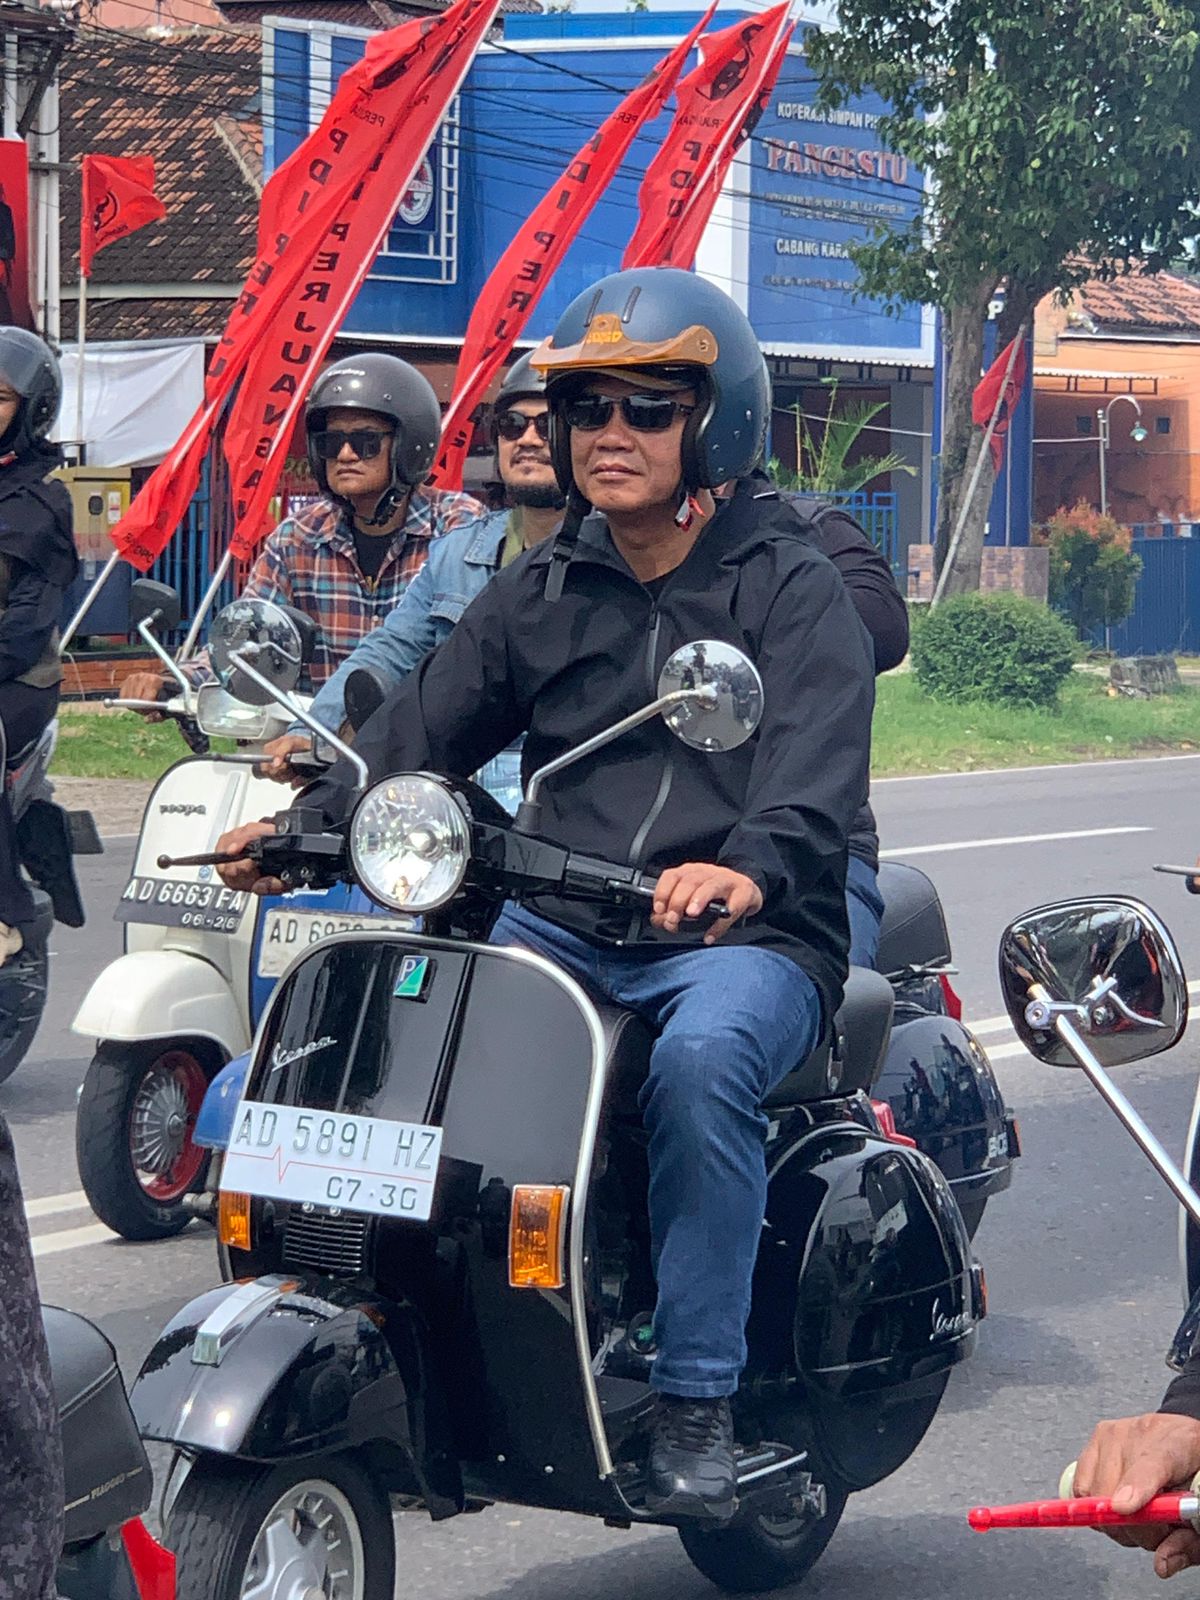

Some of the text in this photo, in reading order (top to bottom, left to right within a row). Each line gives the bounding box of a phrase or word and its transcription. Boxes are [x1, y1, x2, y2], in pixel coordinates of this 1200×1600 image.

[762, 136, 908, 184] PANGESTU
[776, 238, 850, 260] CABANG KARA
[122, 878, 243, 912] AD 6663 FA
[269, 917, 299, 944] AD
[235, 1107, 437, 1171] AD 5891 HZ
